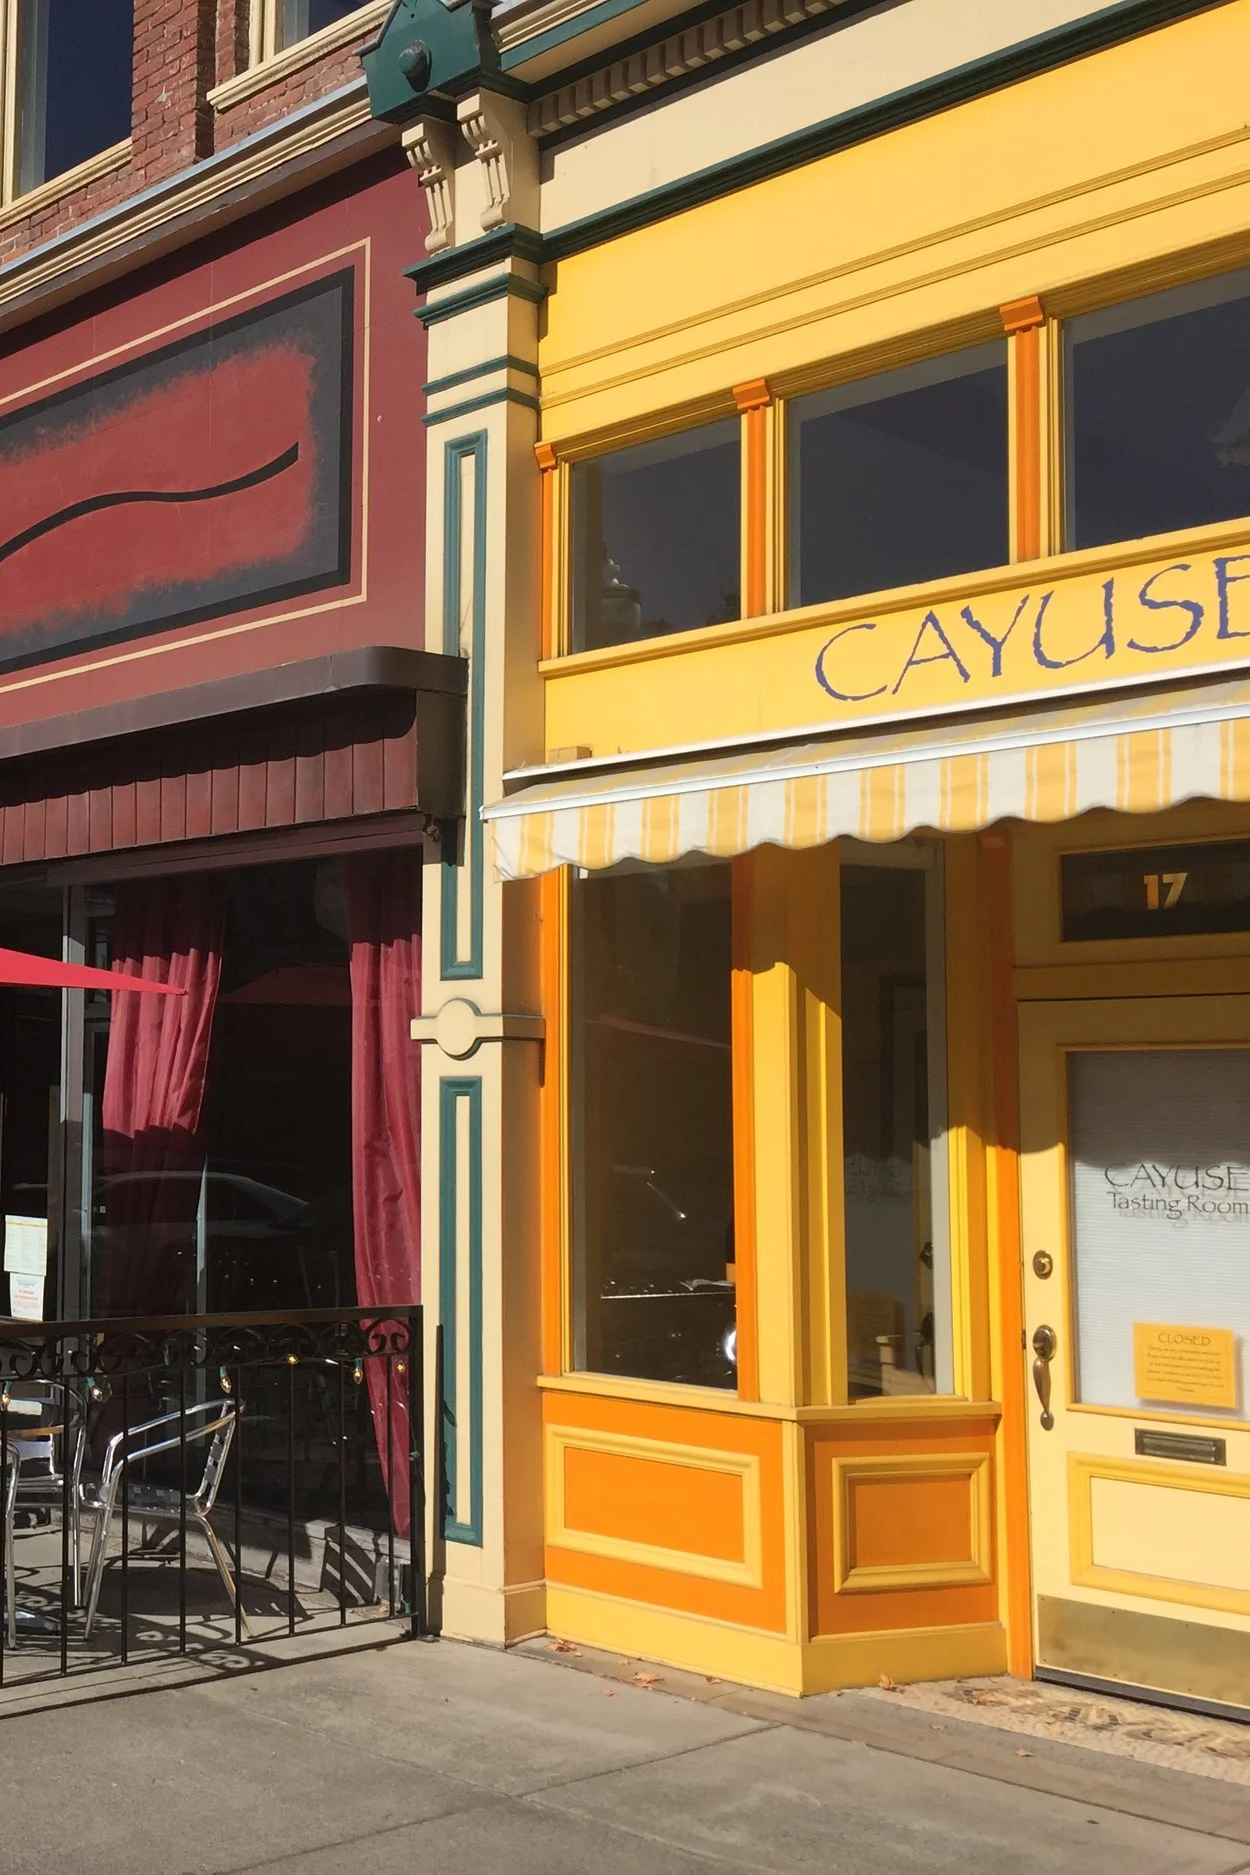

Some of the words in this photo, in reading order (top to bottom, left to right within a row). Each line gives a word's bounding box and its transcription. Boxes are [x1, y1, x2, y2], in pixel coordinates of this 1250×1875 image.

[815, 555, 1250, 701] CAYUSE
[1143, 872, 1188, 910] 17
[1104, 1163, 1249, 1191] CAYUSE
[1107, 1191, 1182, 1219] Tasting
[1187, 1194, 1248, 1214] Room
[1157, 1332, 1212, 1347] CLOSED
